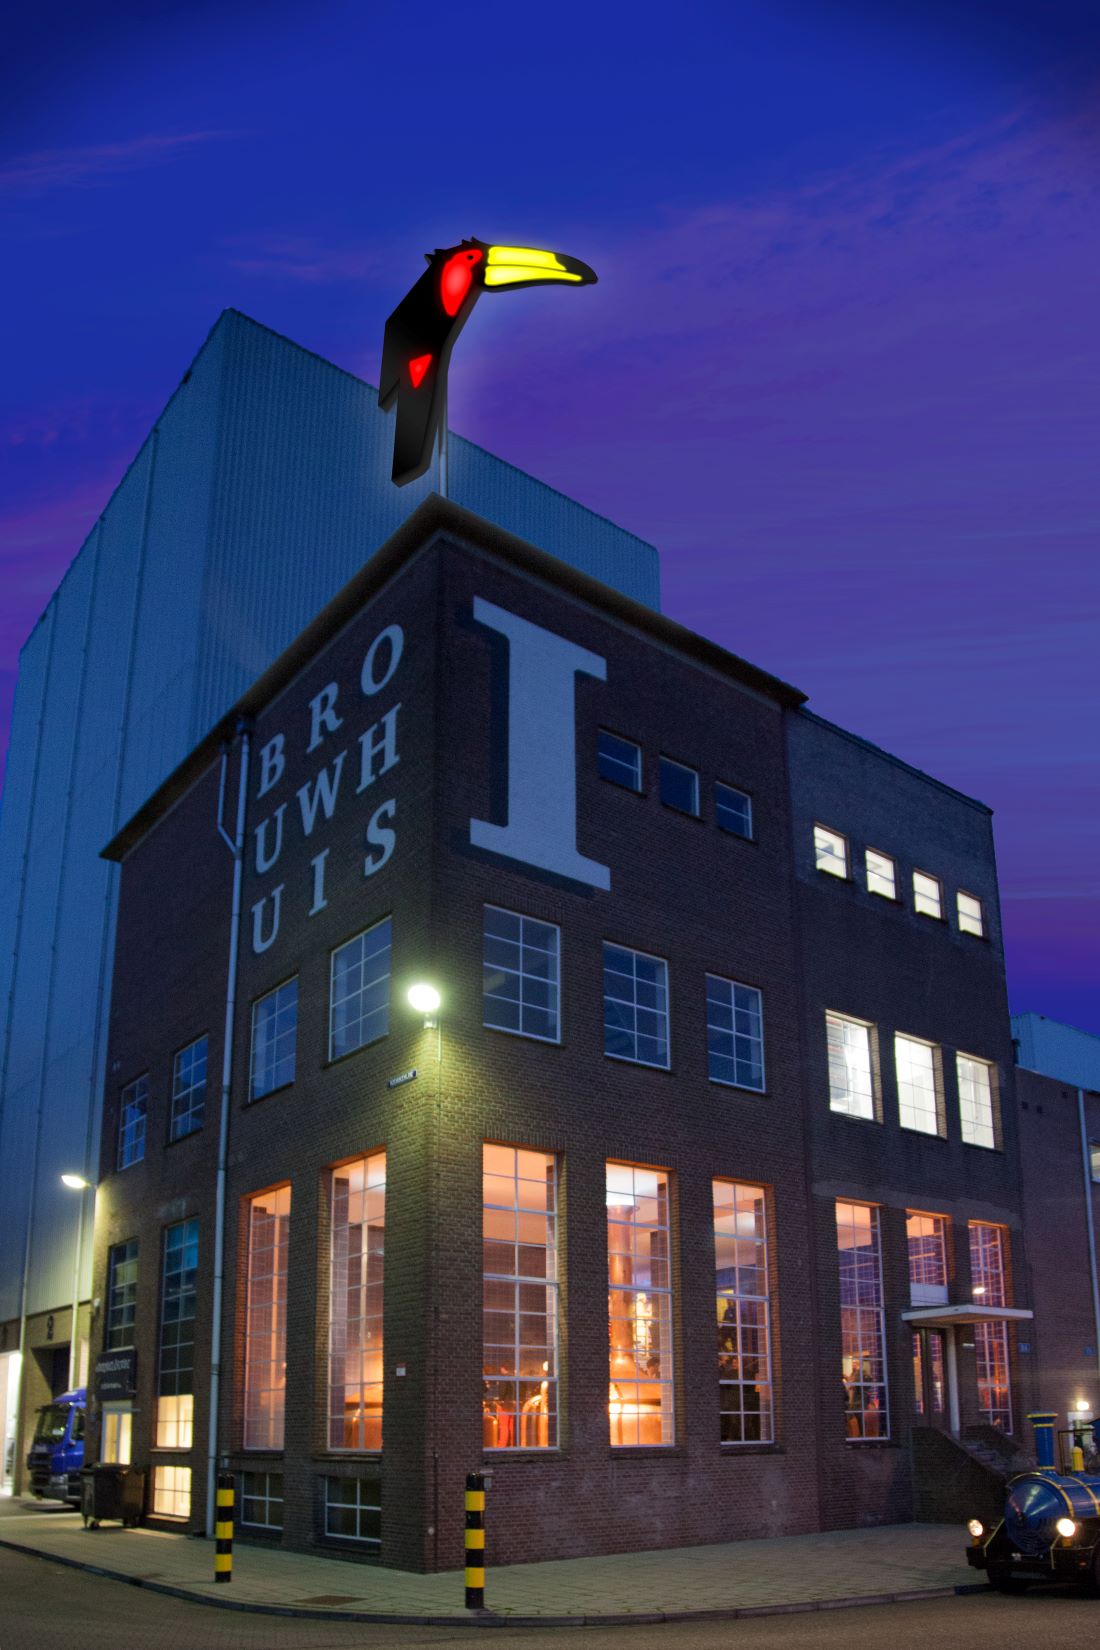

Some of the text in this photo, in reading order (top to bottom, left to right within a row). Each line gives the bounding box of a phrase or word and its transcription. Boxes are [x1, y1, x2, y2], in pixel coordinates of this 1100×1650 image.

[254, 704, 401, 873] UWH
[257, 625, 404, 798] BRO
[471, 595, 610, 891] I
[251, 799, 396, 954] UIS
